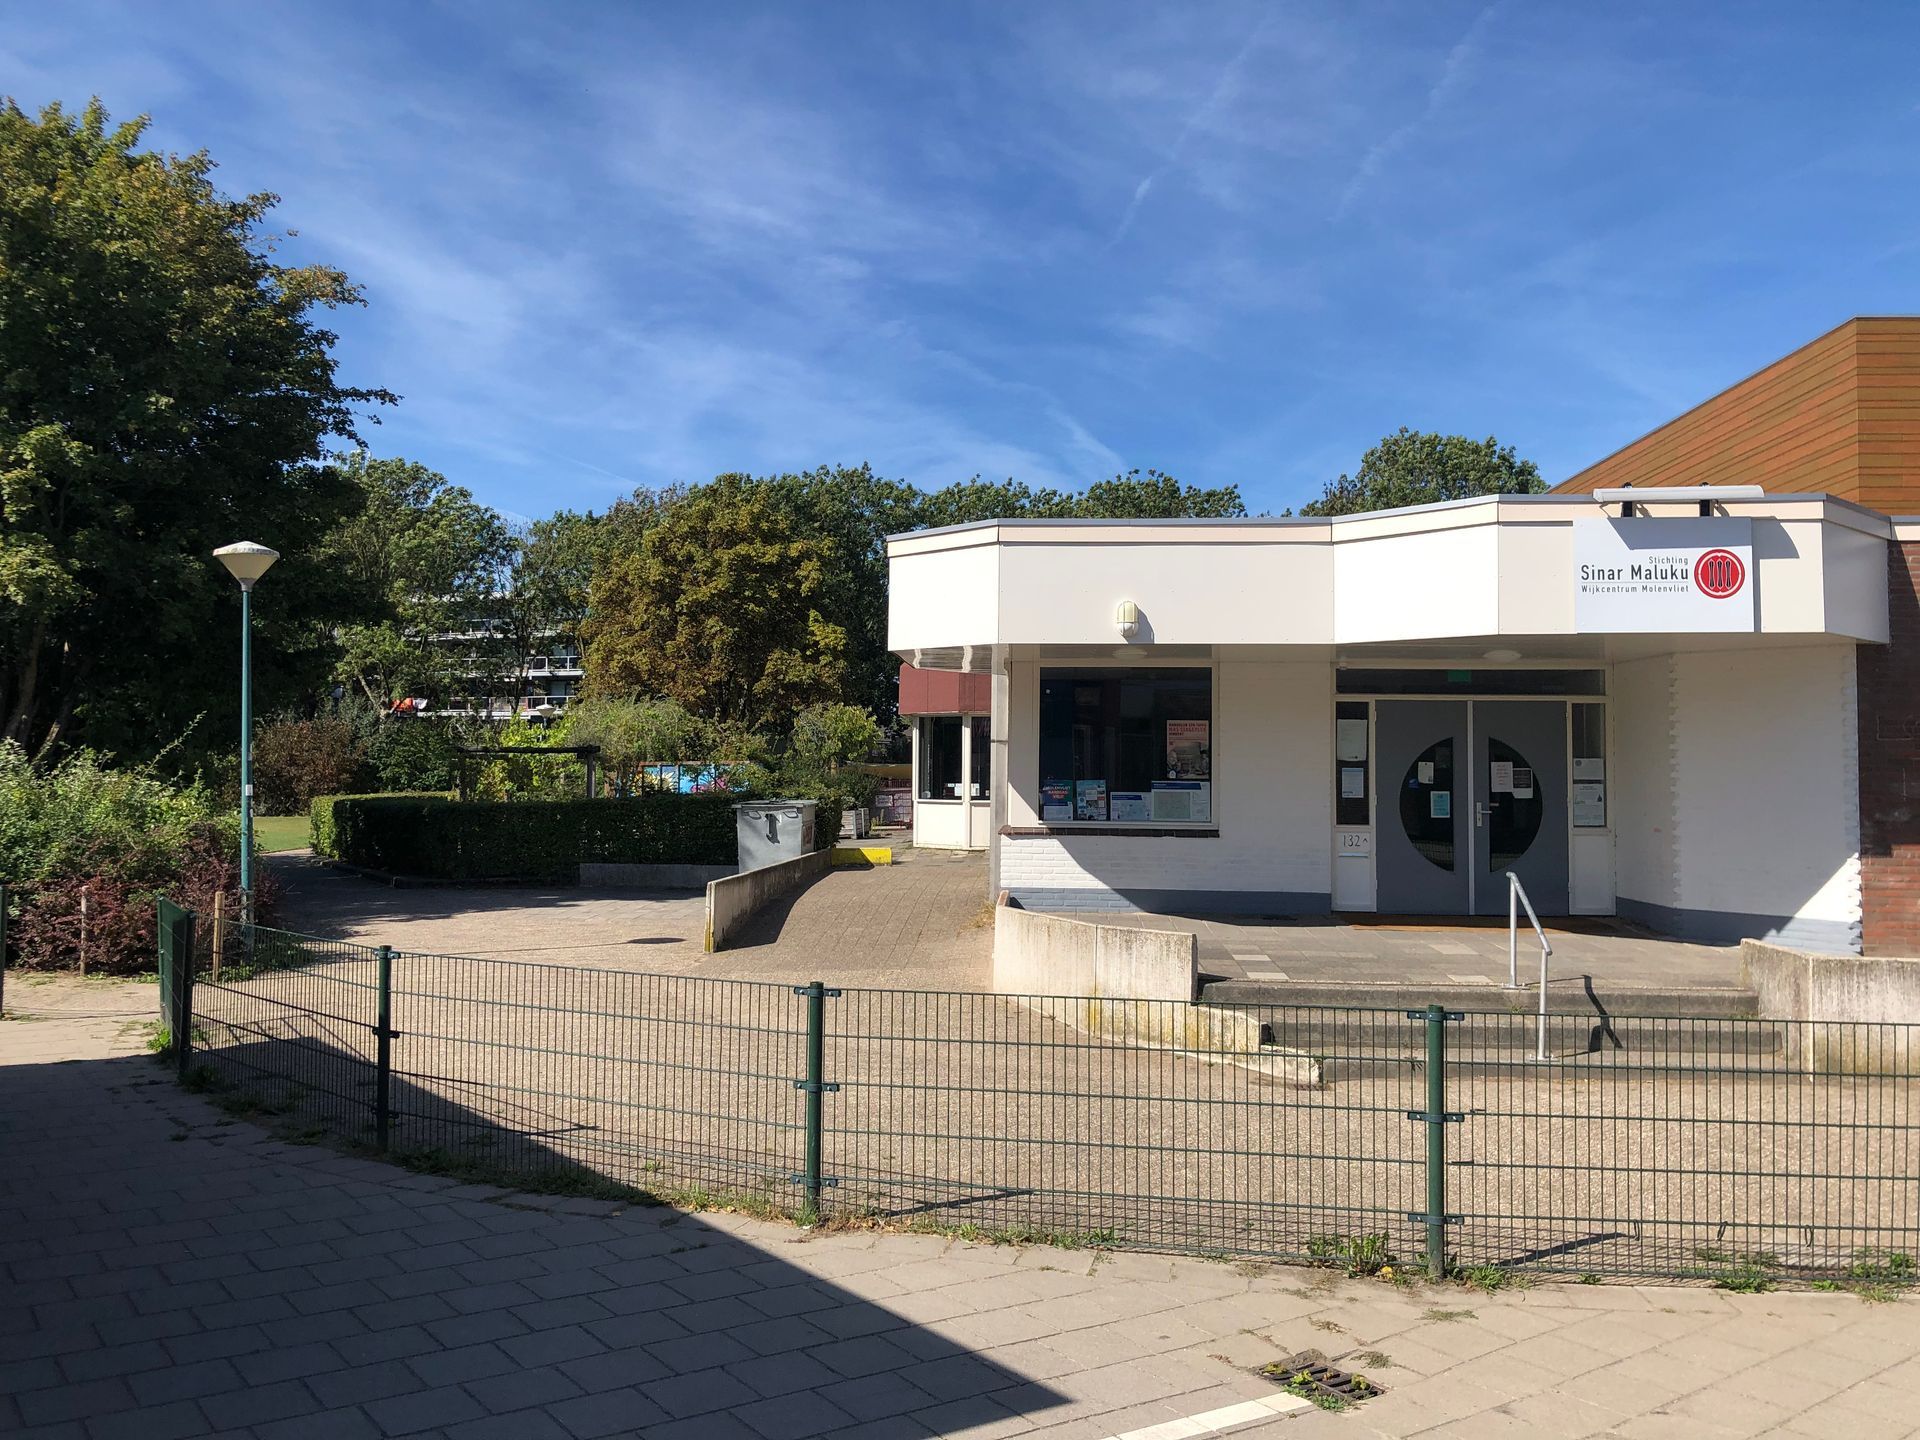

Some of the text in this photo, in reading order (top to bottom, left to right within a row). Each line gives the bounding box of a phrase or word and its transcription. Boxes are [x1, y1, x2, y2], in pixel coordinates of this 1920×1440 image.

[1648, 556, 1689, 566] Stichting
[1581, 564, 1689, 581] Sinar Maluku
[1581, 584, 1689, 595] Wijkcentrum Molenvliet
